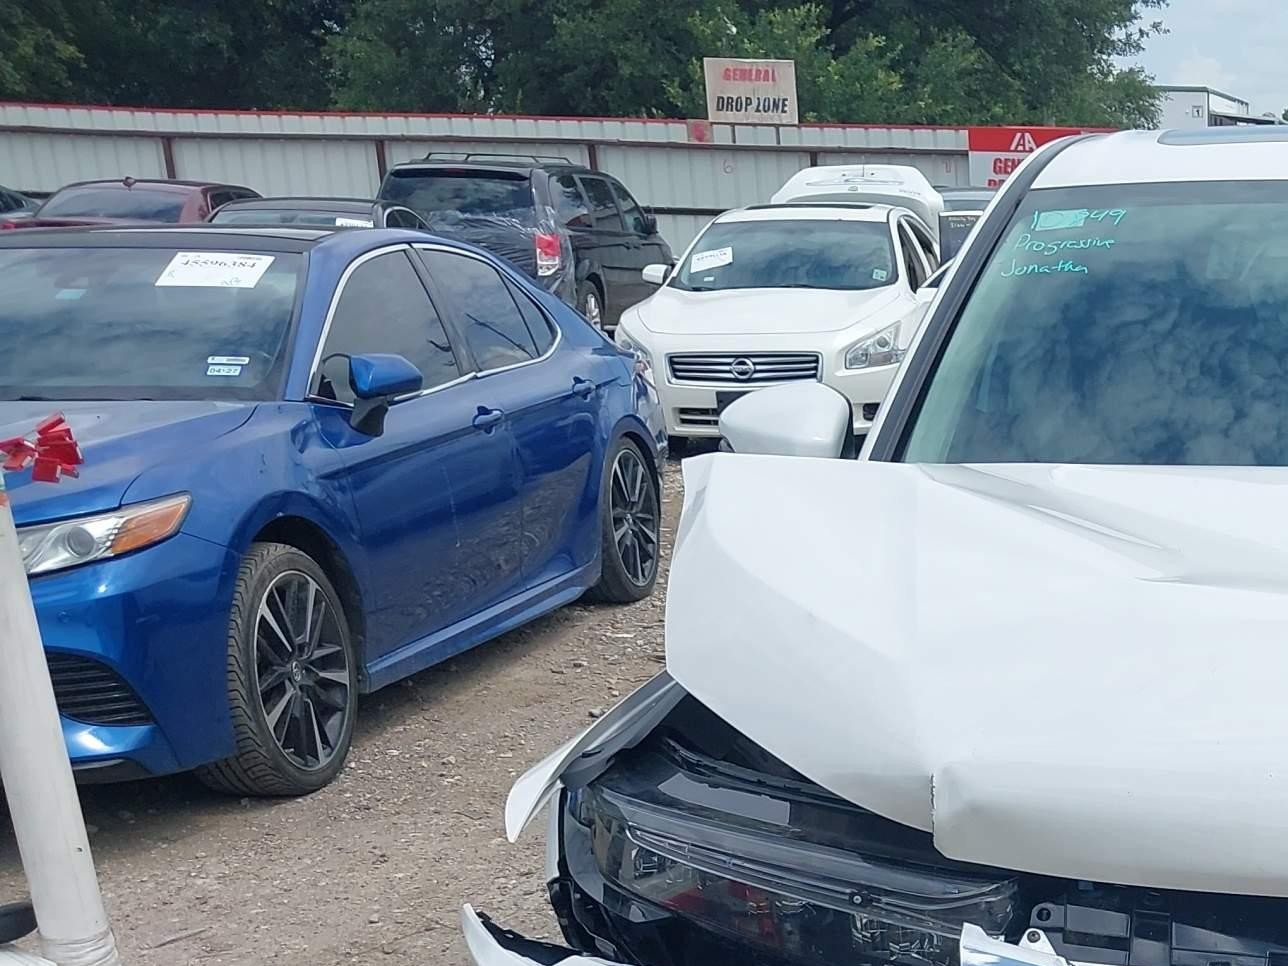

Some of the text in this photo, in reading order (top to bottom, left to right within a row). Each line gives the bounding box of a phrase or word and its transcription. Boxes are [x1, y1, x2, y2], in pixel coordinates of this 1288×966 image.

[723, 67, 777, 82] GENERAL
[716, 96, 789, 113] DROP ZONE
